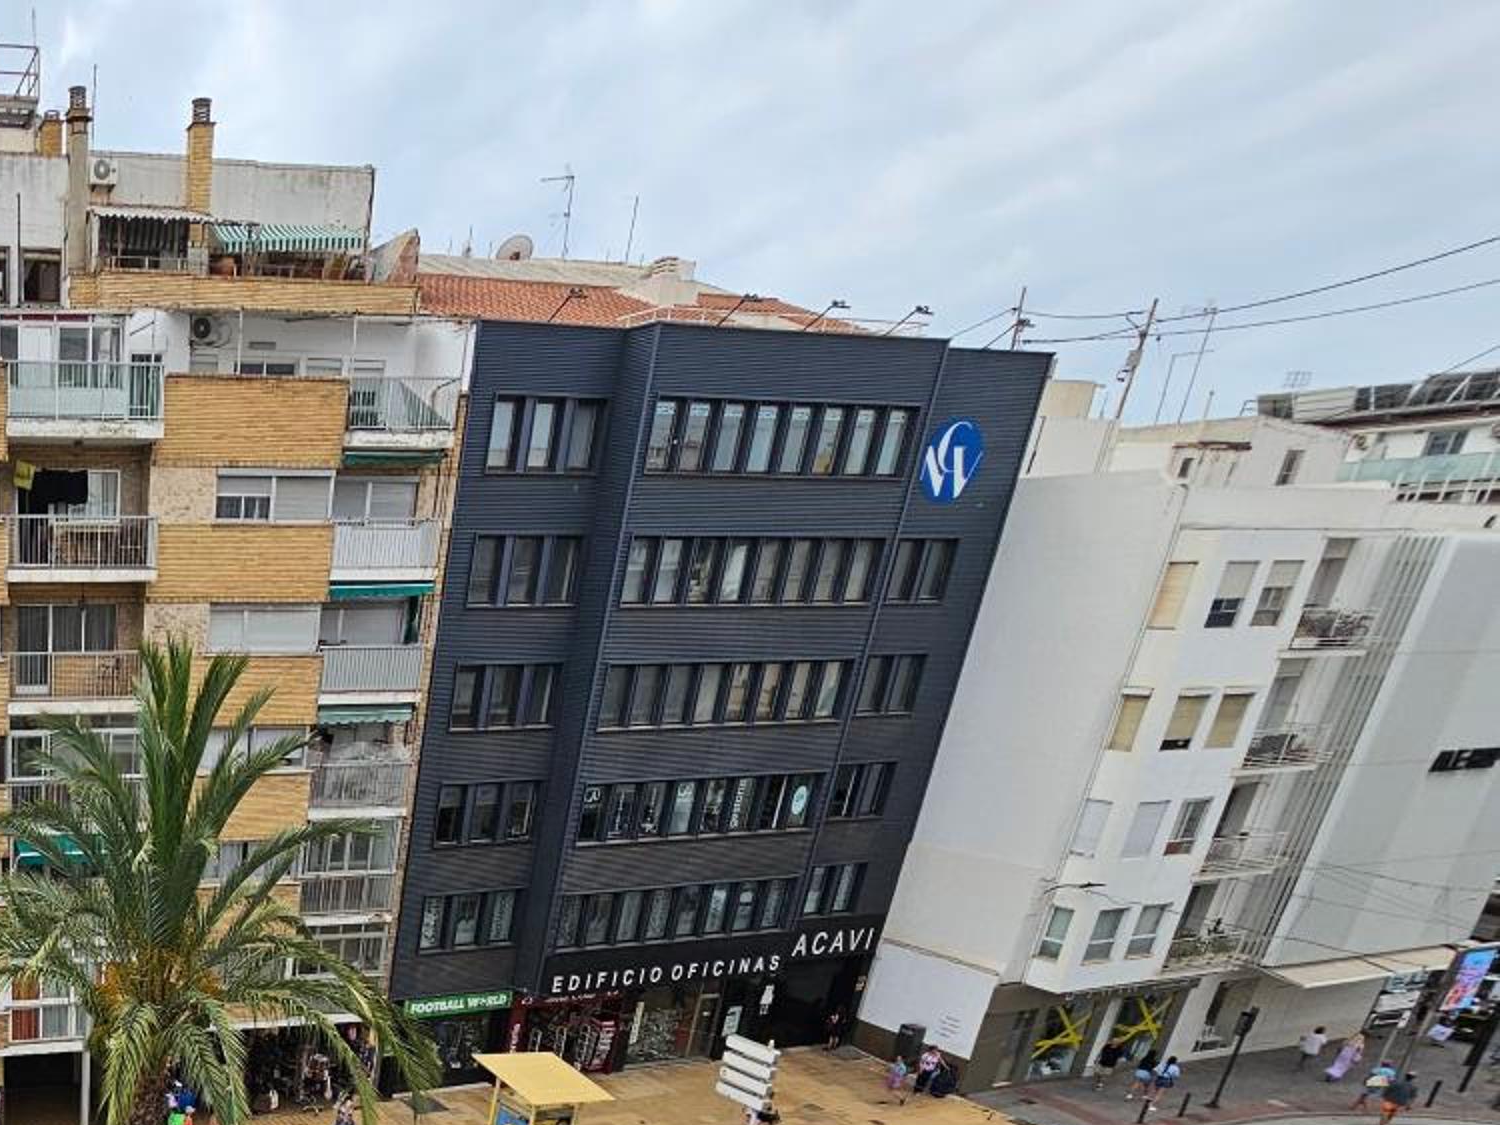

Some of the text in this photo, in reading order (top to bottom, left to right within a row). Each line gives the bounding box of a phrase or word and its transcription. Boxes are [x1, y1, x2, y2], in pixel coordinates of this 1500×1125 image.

[551, 927, 874, 993] EDIFICIO OFICINAS ACAVI
[410, 997, 465, 1015] FOOTBALL
